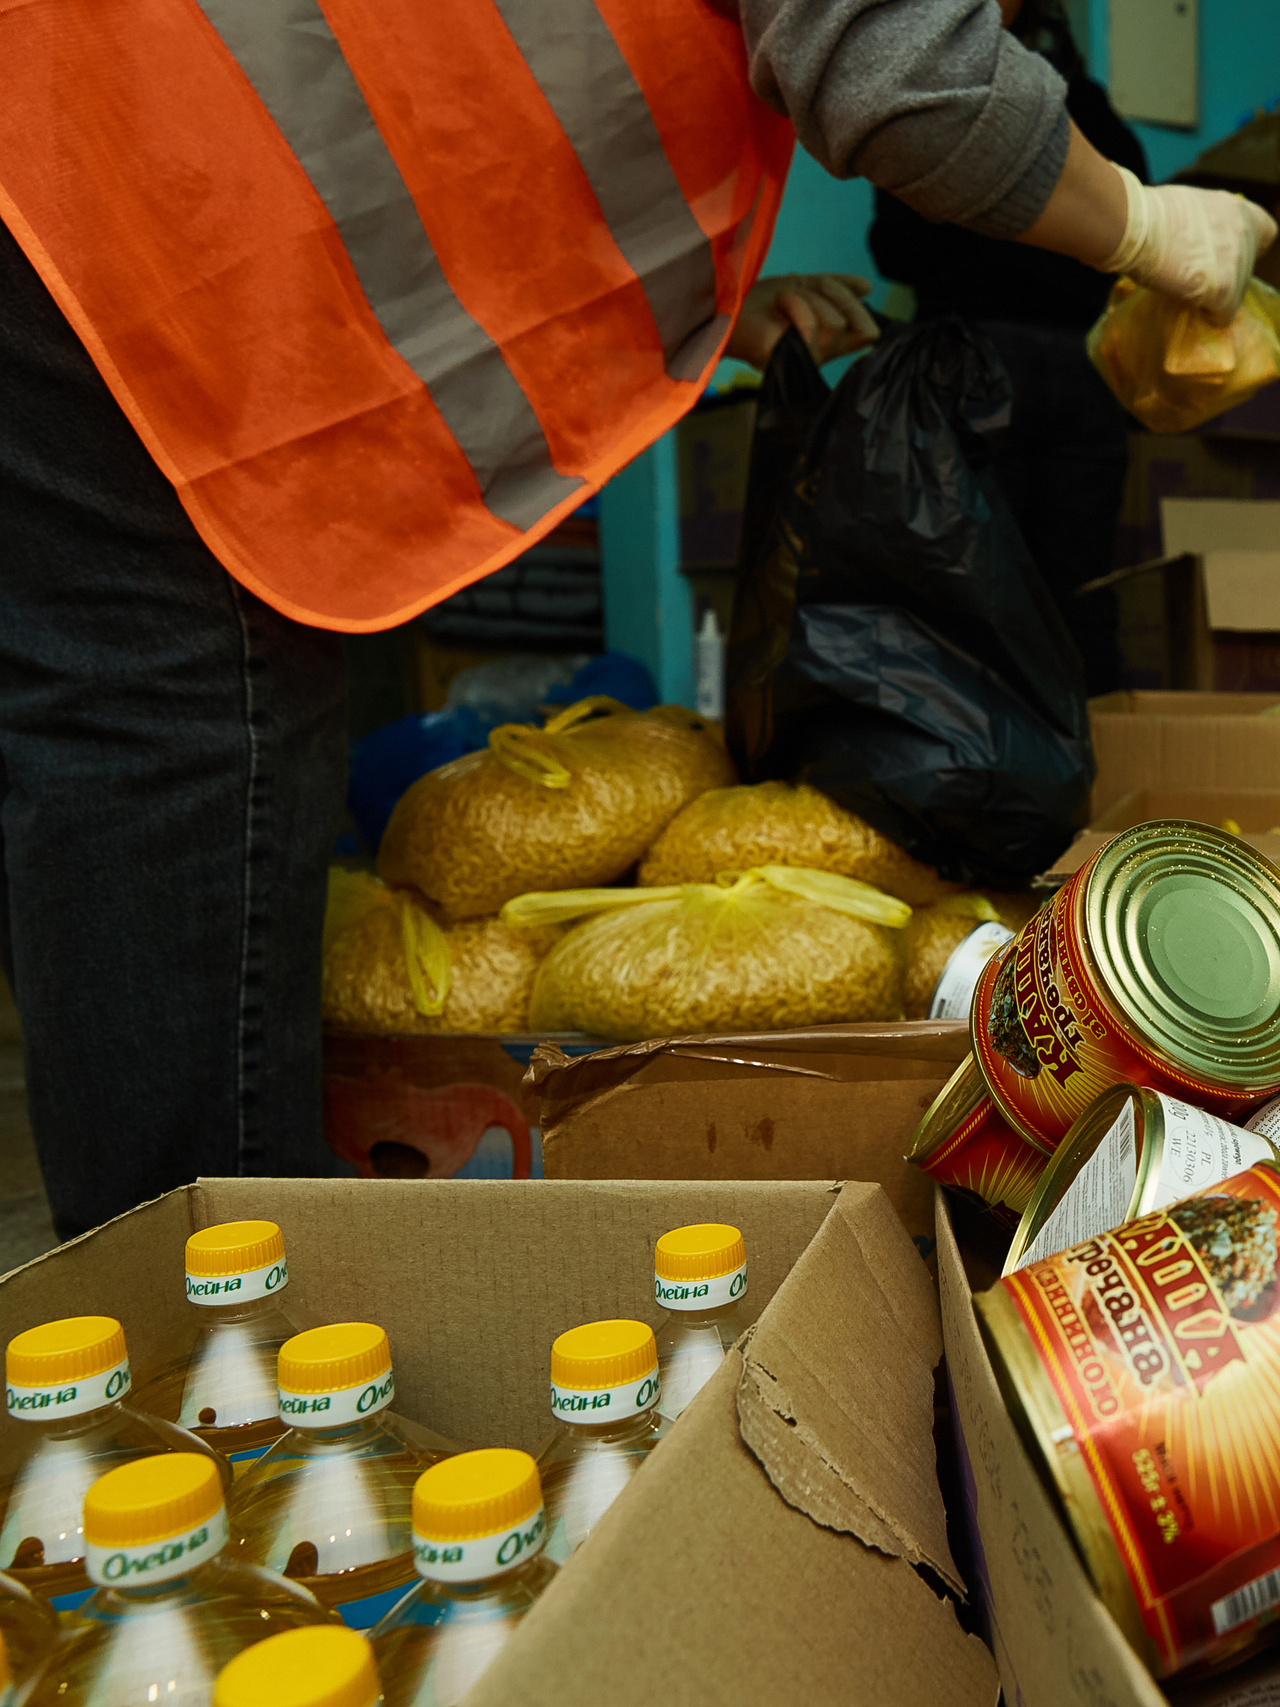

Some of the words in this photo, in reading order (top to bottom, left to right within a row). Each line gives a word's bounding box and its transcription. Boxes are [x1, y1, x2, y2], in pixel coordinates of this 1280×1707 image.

[1081, 1008, 1108, 1041] зі
[1170, 1136, 1183, 1159] WE
[1183, 1129, 1197, 1185] 22130306
[1201, 1150, 1212, 1167] PL
[186, 1277, 242, 1296] Олейна
[655, 1279, 709, 1300] Олейна
[1107, 1206, 1247, 1398] АША
[550, 1387, 611, 1411] Олейна
[102, 1527, 209, 1580] Олейна
